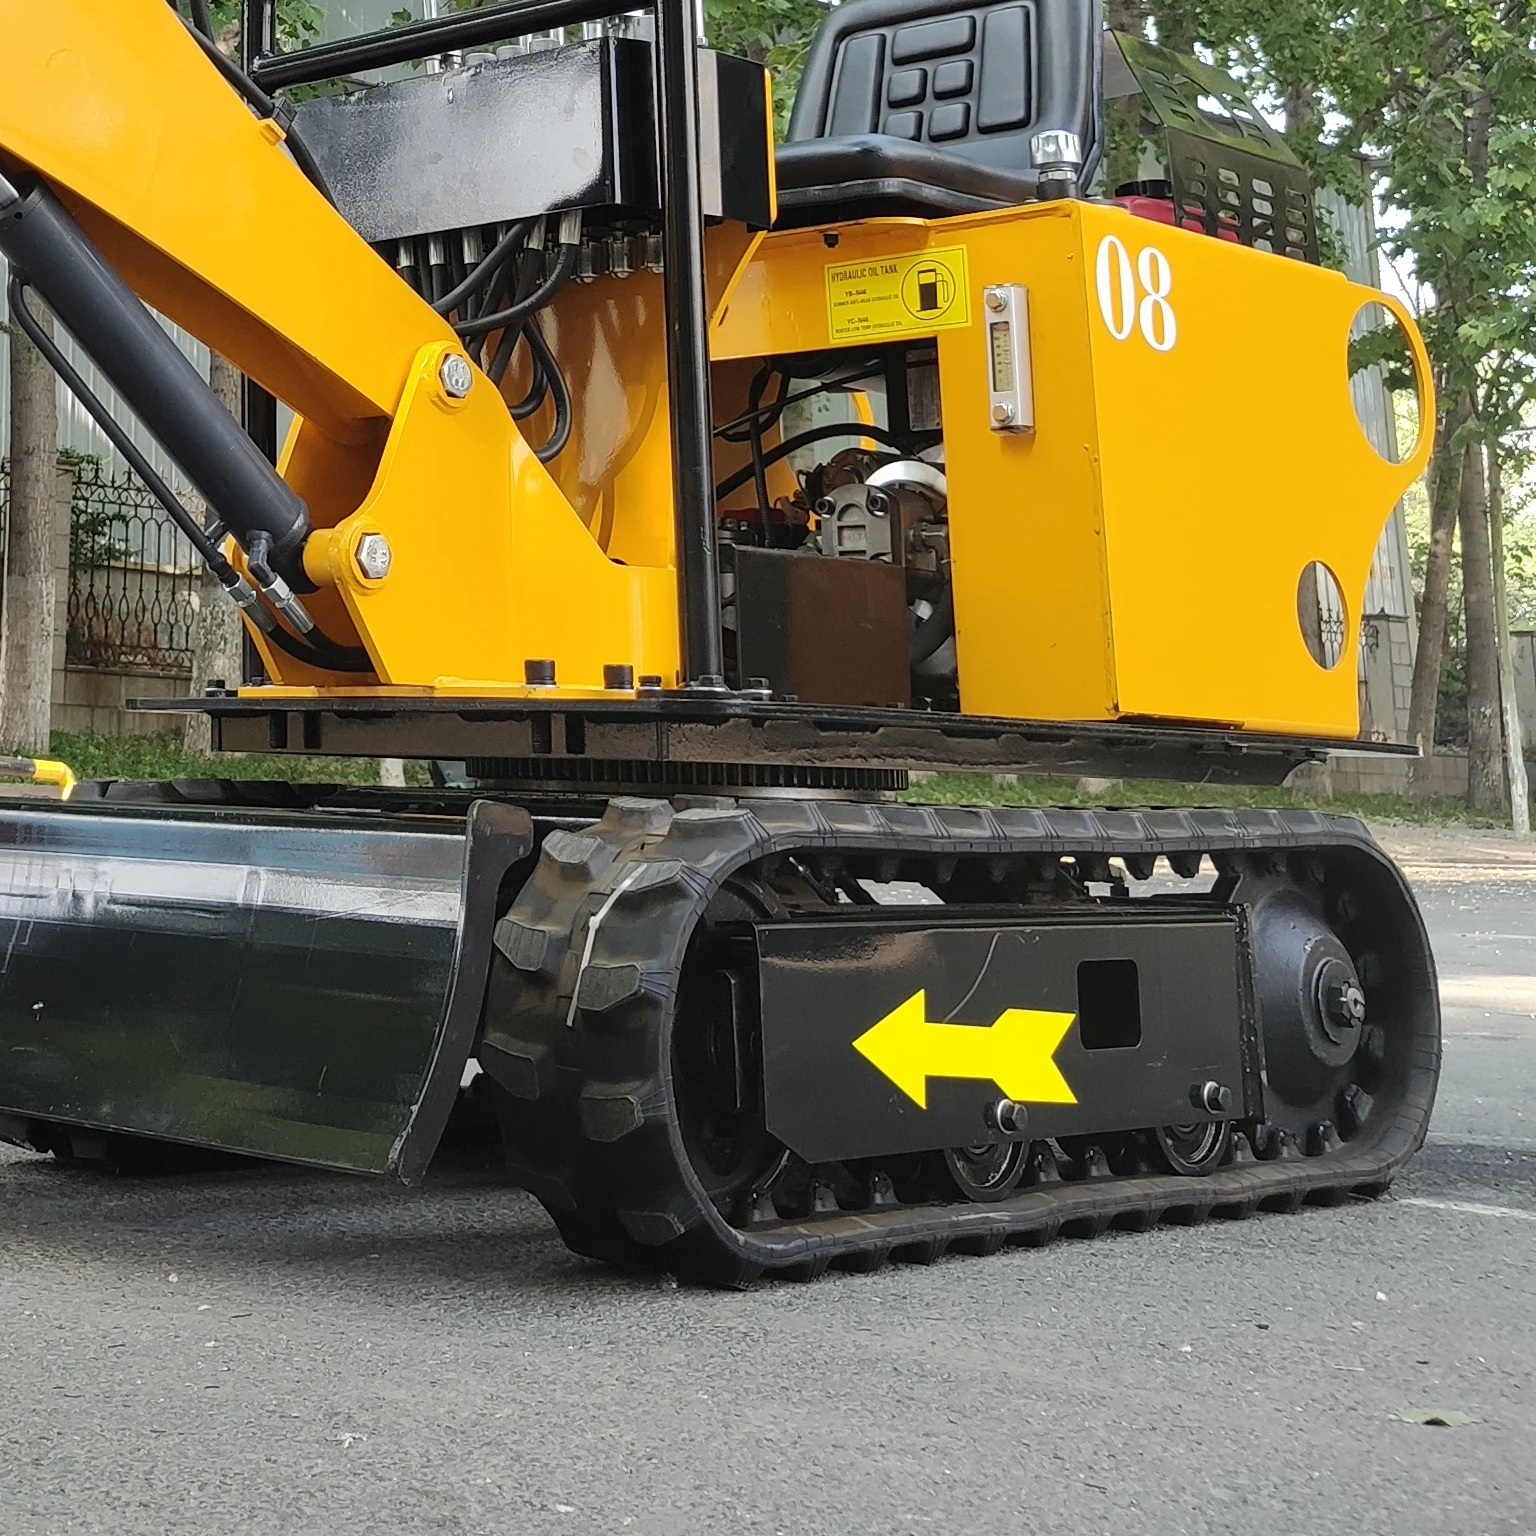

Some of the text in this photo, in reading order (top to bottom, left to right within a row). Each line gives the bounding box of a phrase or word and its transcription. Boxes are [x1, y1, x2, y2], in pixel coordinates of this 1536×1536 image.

[831, 264, 898, 283] HYDRAULIC OIL TANK
[1095, 234, 1177, 352] 08
